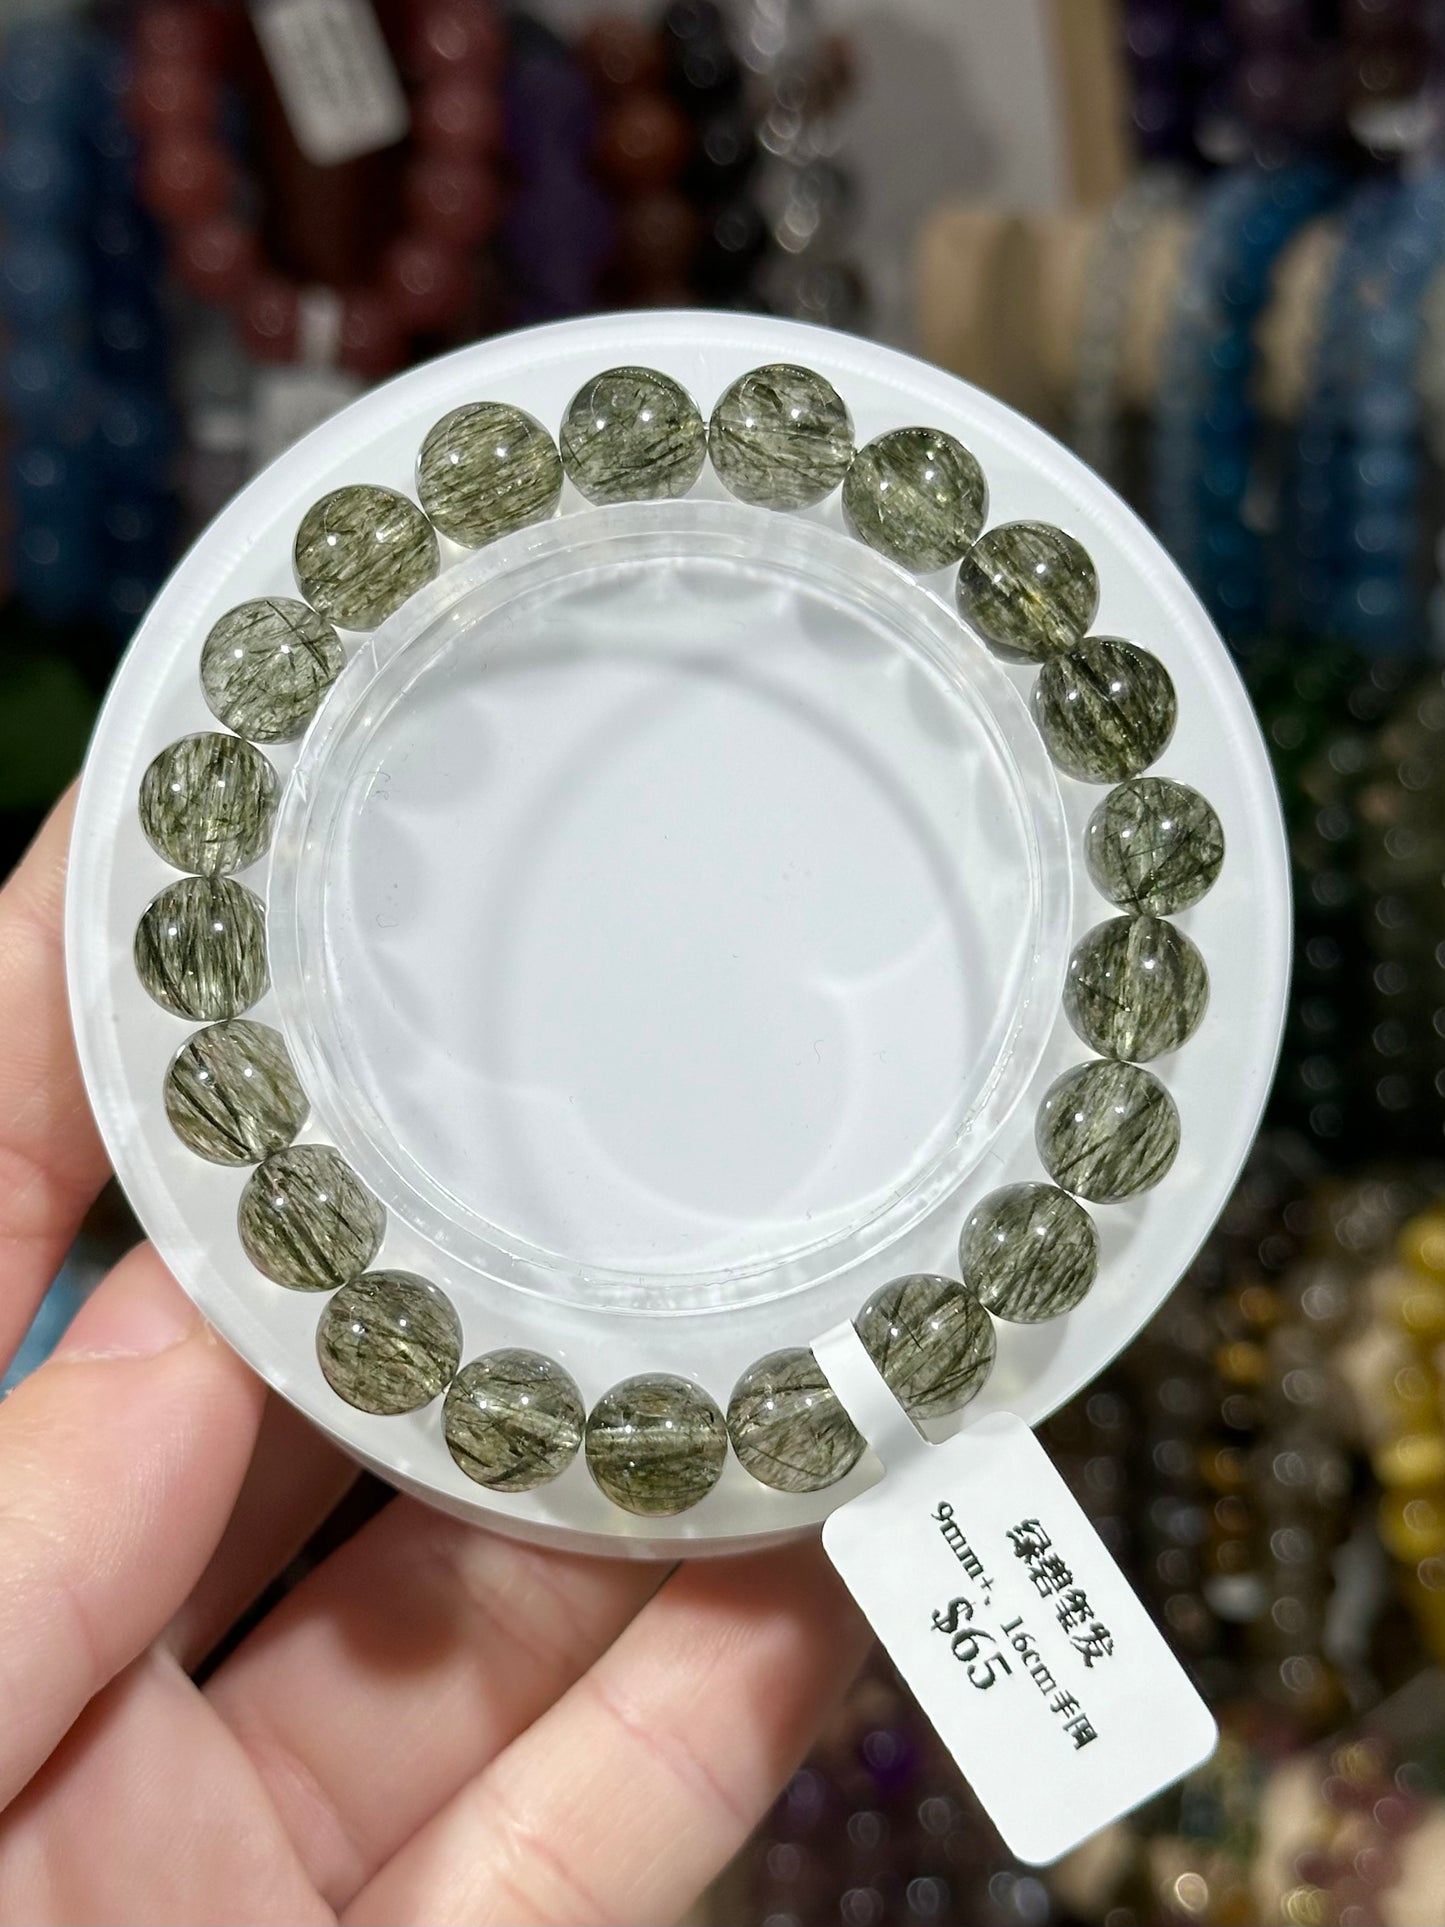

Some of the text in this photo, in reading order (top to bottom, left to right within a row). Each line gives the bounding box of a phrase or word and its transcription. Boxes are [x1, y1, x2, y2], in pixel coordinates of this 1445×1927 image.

[931, 1597, 1012, 1690] $65
[1006, 1518, 1114, 1668] 绿碧玺发
